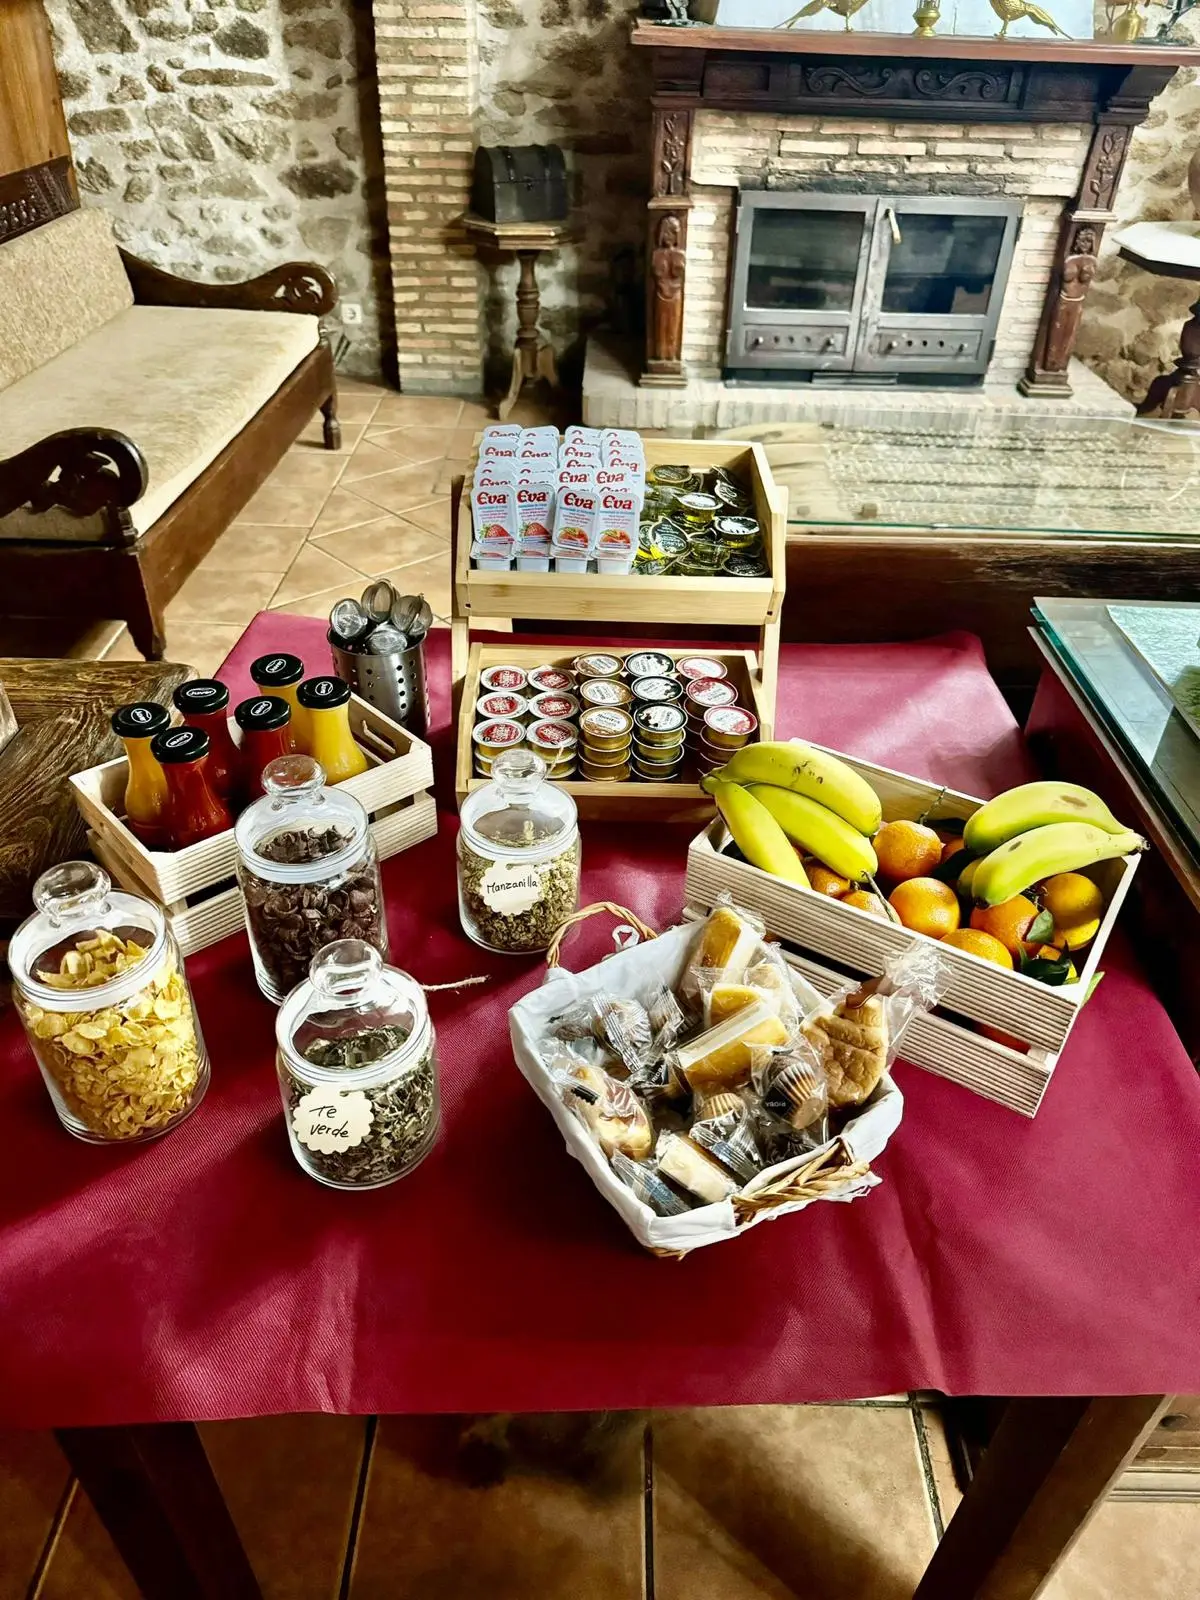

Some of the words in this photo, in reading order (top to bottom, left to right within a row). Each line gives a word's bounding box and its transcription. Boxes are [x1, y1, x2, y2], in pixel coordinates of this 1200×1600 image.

[558, 471, 588, 483] Eva
[596, 471, 625, 484] Eva
[477, 491, 507, 505] Eva
[517, 489, 547, 504] Eva
[564, 492, 594, 509] Eva
[602, 495, 632, 510] Eva
[486, 874, 538, 894] Manzanilla
[308, 1105, 338, 1119] Te
